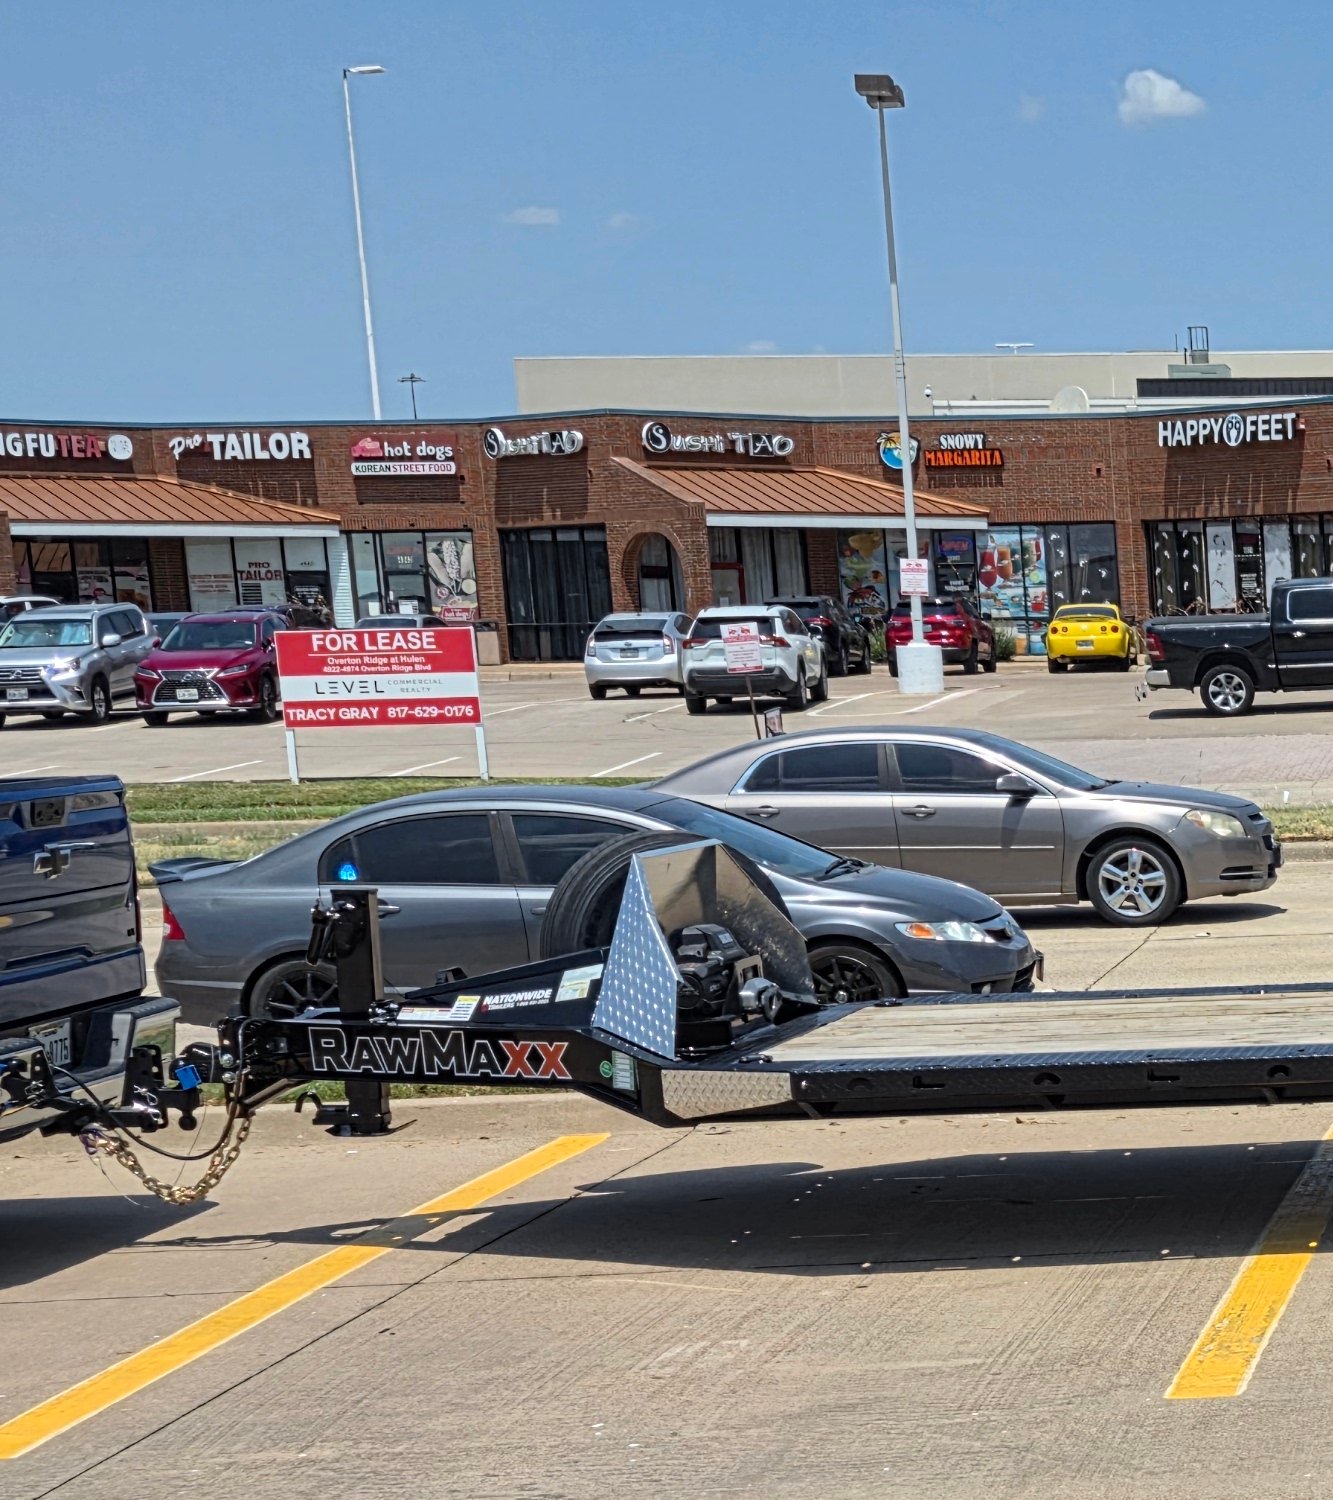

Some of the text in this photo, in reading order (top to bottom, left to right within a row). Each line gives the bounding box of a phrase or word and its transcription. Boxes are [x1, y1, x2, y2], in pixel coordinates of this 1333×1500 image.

[1158, 412, 1297, 447] HAPPY FEET
[206, 432, 312, 460] TAILOR
[939, 433, 985, 450] SNOWY
[383, 441, 453, 460] hot dogs
[924, 450, 1003, 467] MARGARITA
[354, 463, 452, 473] KOREAN STREET FOOD
[311, 632, 437, 652] FOR LEASE
[315, 680, 385, 695] LEVEL
[286, 705, 474, 721] TRACY GRAY 817-629-0176
[483, 989, 552, 1005] NATIONWIDE
